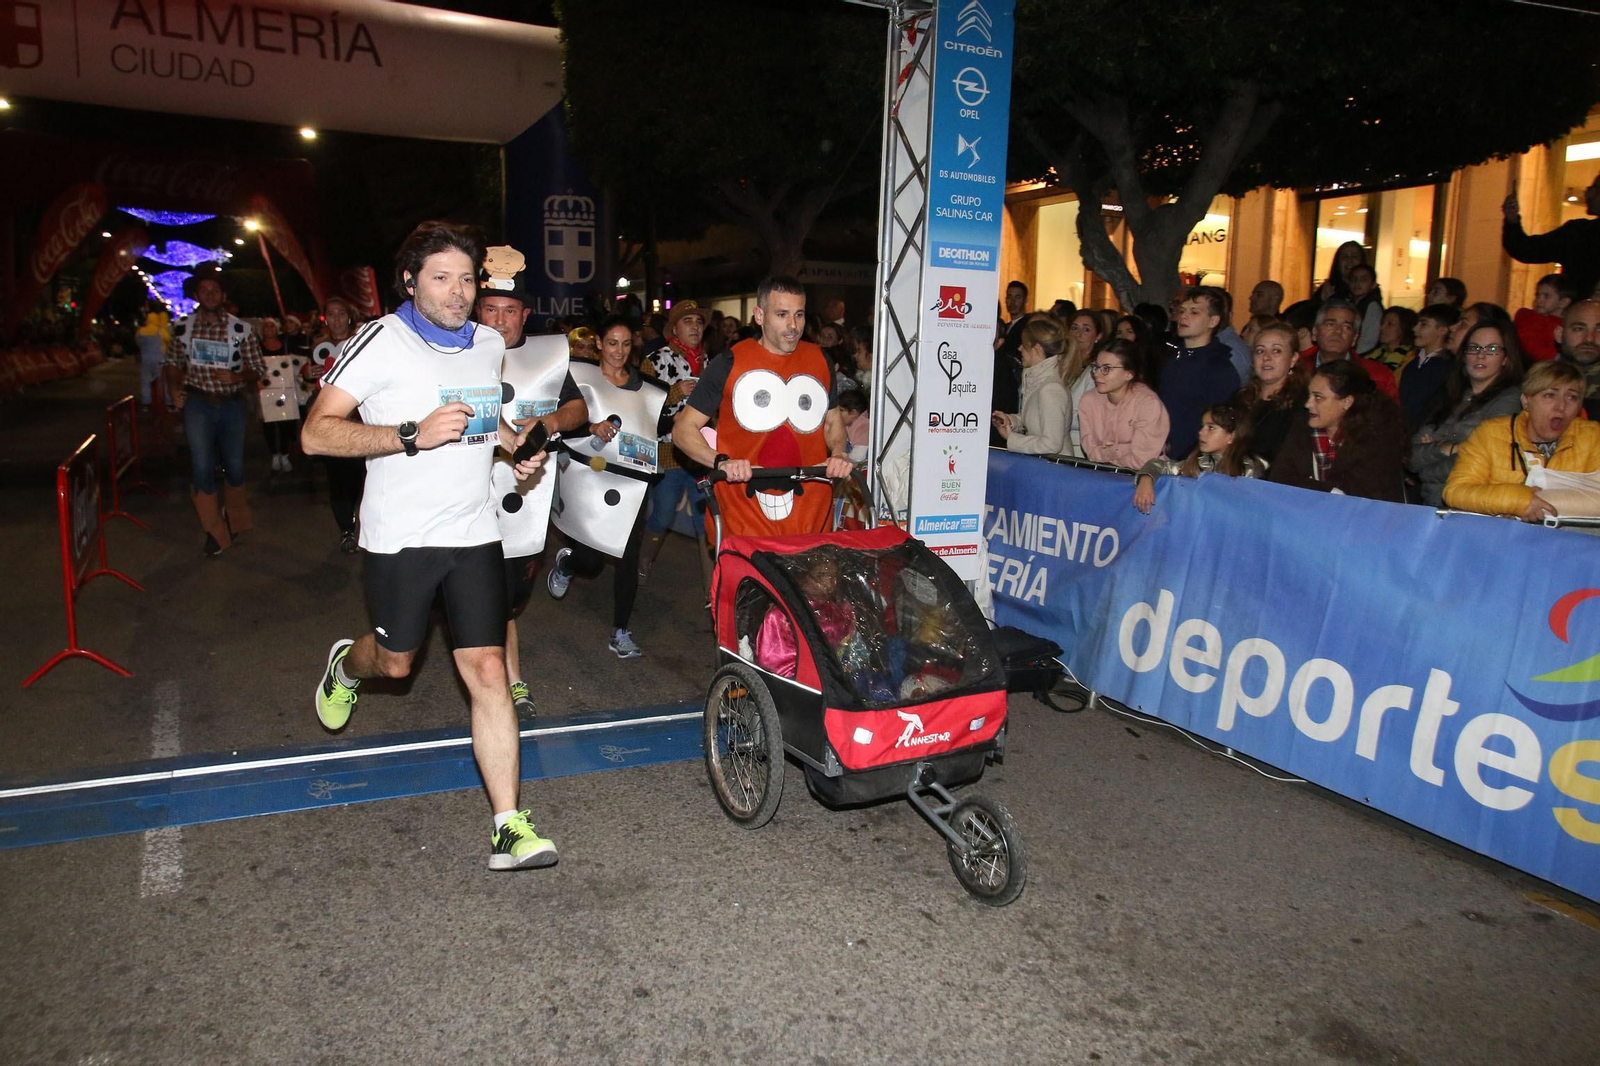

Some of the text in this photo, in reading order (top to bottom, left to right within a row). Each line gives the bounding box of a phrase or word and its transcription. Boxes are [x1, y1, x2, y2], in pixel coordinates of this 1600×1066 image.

[110, 0, 383, 67] ALMERÍA
[944, 40, 1003, 59] CITROËN
[110, 43, 256, 88] CIUDAD
[959, 108, 980, 120] OPEL
[939, 169, 996, 184] DS AUTOMOBILES
[950, 194, 982, 207] GRUPO
[936, 206, 993, 222] SALINAS CAR
[938, 246, 990, 262] DECATHLON
[928, 411, 979, 428] DUNA
[635, 443, 655, 459] 1570
[917, 518, 960, 532] Almericar
[940, 548, 949, 556] de
[948, 546, 977, 555] Almería
[1119, 588, 1600, 845] deportes
